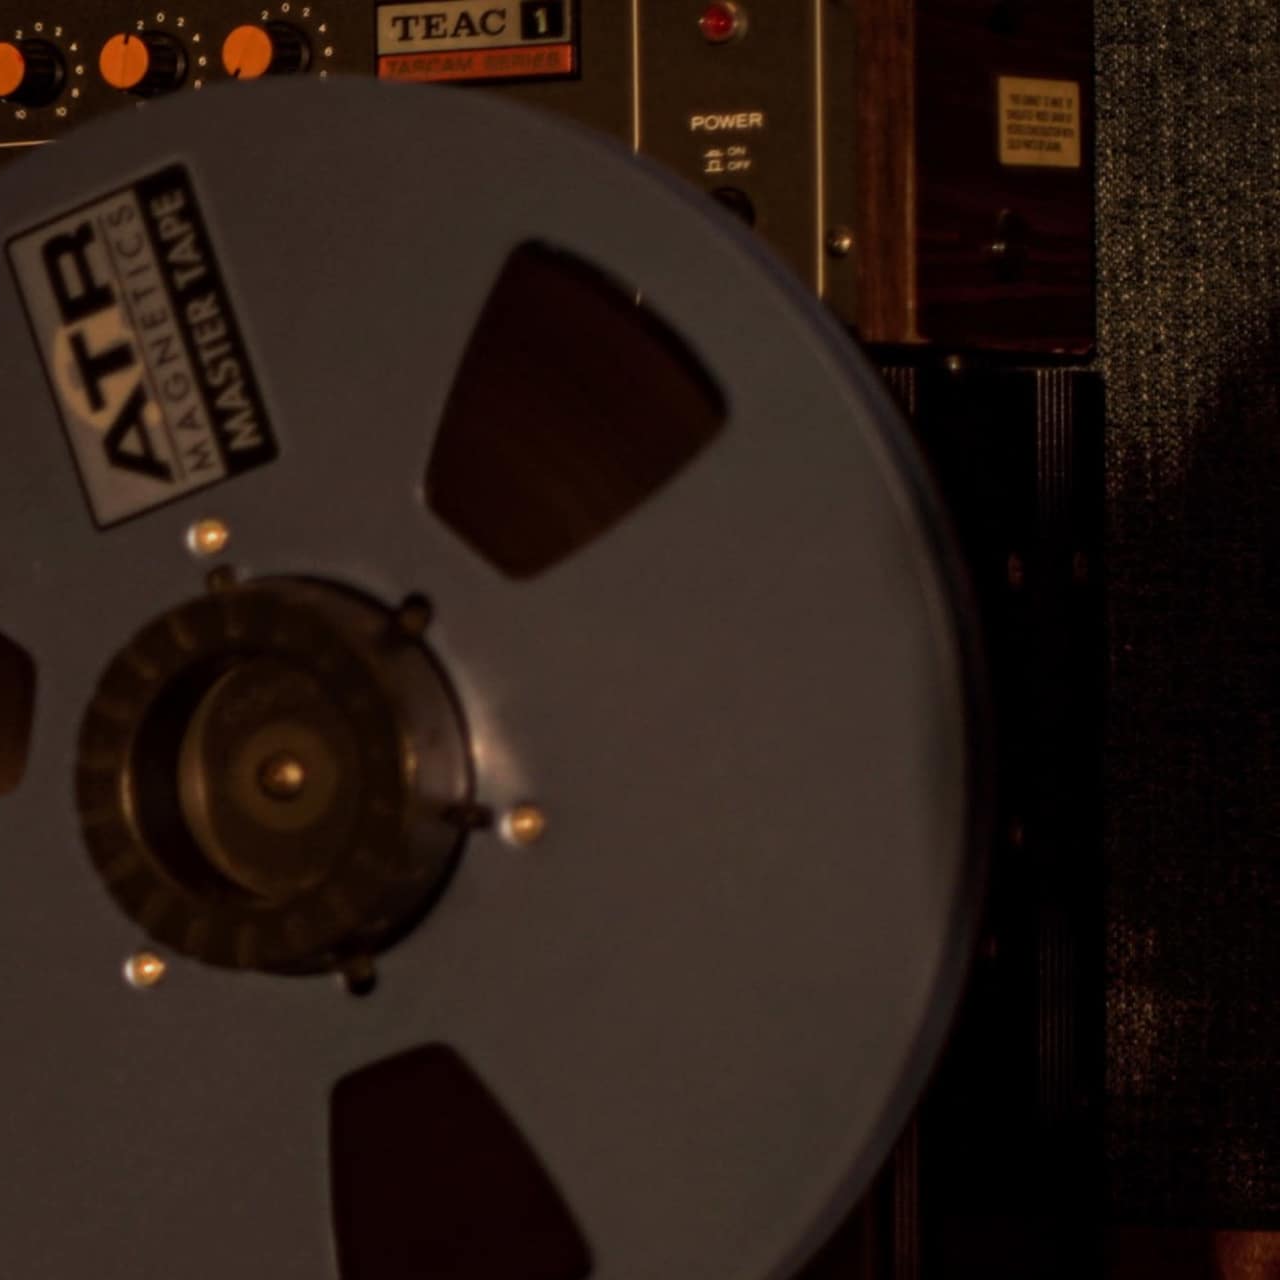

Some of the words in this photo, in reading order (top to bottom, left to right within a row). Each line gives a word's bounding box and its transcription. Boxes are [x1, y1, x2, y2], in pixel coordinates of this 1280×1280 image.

[391, 8, 507, 41] TEAC
[690, 112, 764, 132] POWER
[727, 146, 747, 157] ON
[727, 160, 752, 172] OFF
[148, 190, 208, 292] TAPE
[44, 222, 175, 482] ATR
[109, 204, 213, 472] MAGNETICS
[187, 297, 265, 452] MASTER
